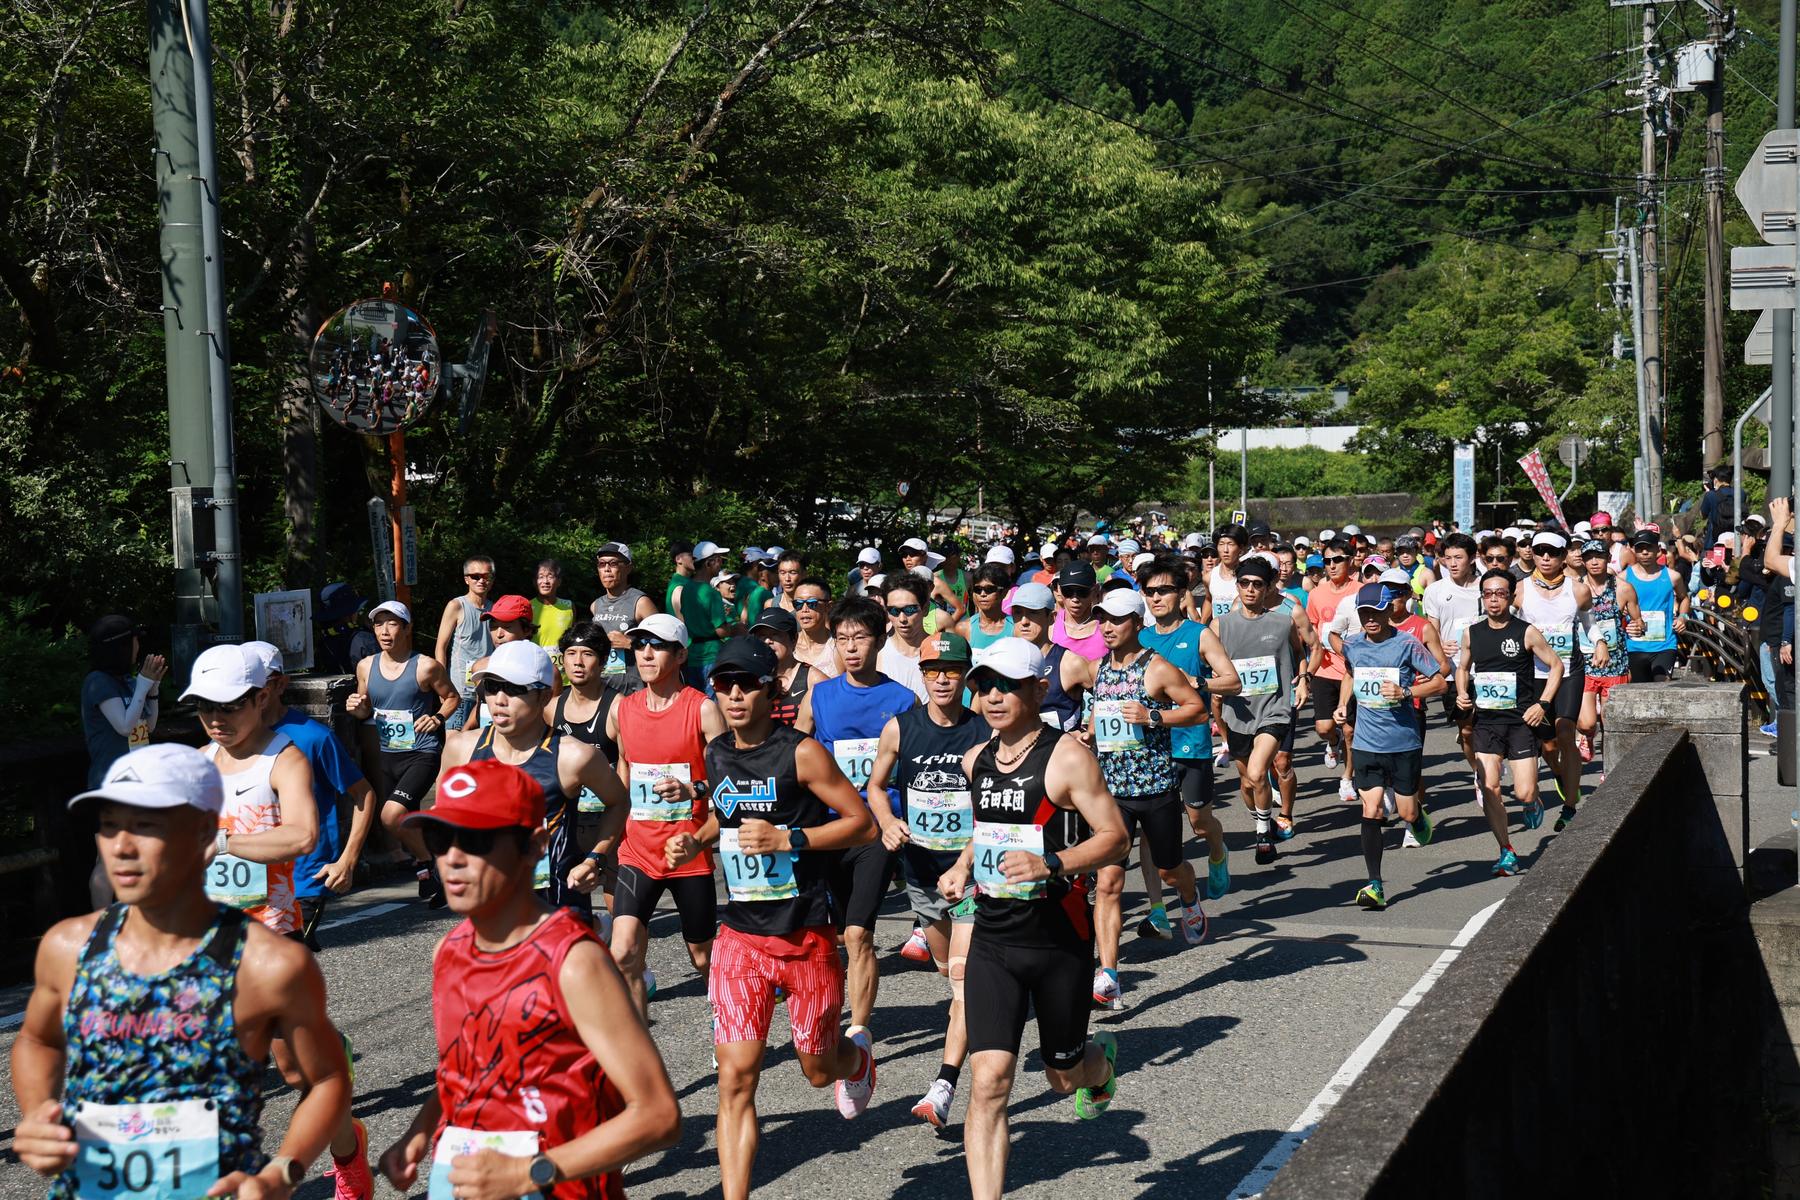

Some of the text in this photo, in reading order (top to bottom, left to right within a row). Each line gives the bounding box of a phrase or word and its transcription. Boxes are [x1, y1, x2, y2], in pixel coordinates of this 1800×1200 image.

[1236, 514, 1243, 523] P
[1216, 603, 1231, 614] 33
[1547, 635, 1566, 648] 49
[1240, 669, 1269, 685] 157
[1360, 681, 1380, 696] 40
[1482, 685, 1509, 698] 562
[1100, 718, 1130, 737] 191
[848, 758, 874, 778] 10
[639, 783, 664, 804] 15
[979, 788, 1025, 812] 石田軍団
[916, 812, 961, 833] 428
[213, 861, 250, 888] 30
[731, 854, 779, 879] 192
[97, 1147, 183, 1192] 301
